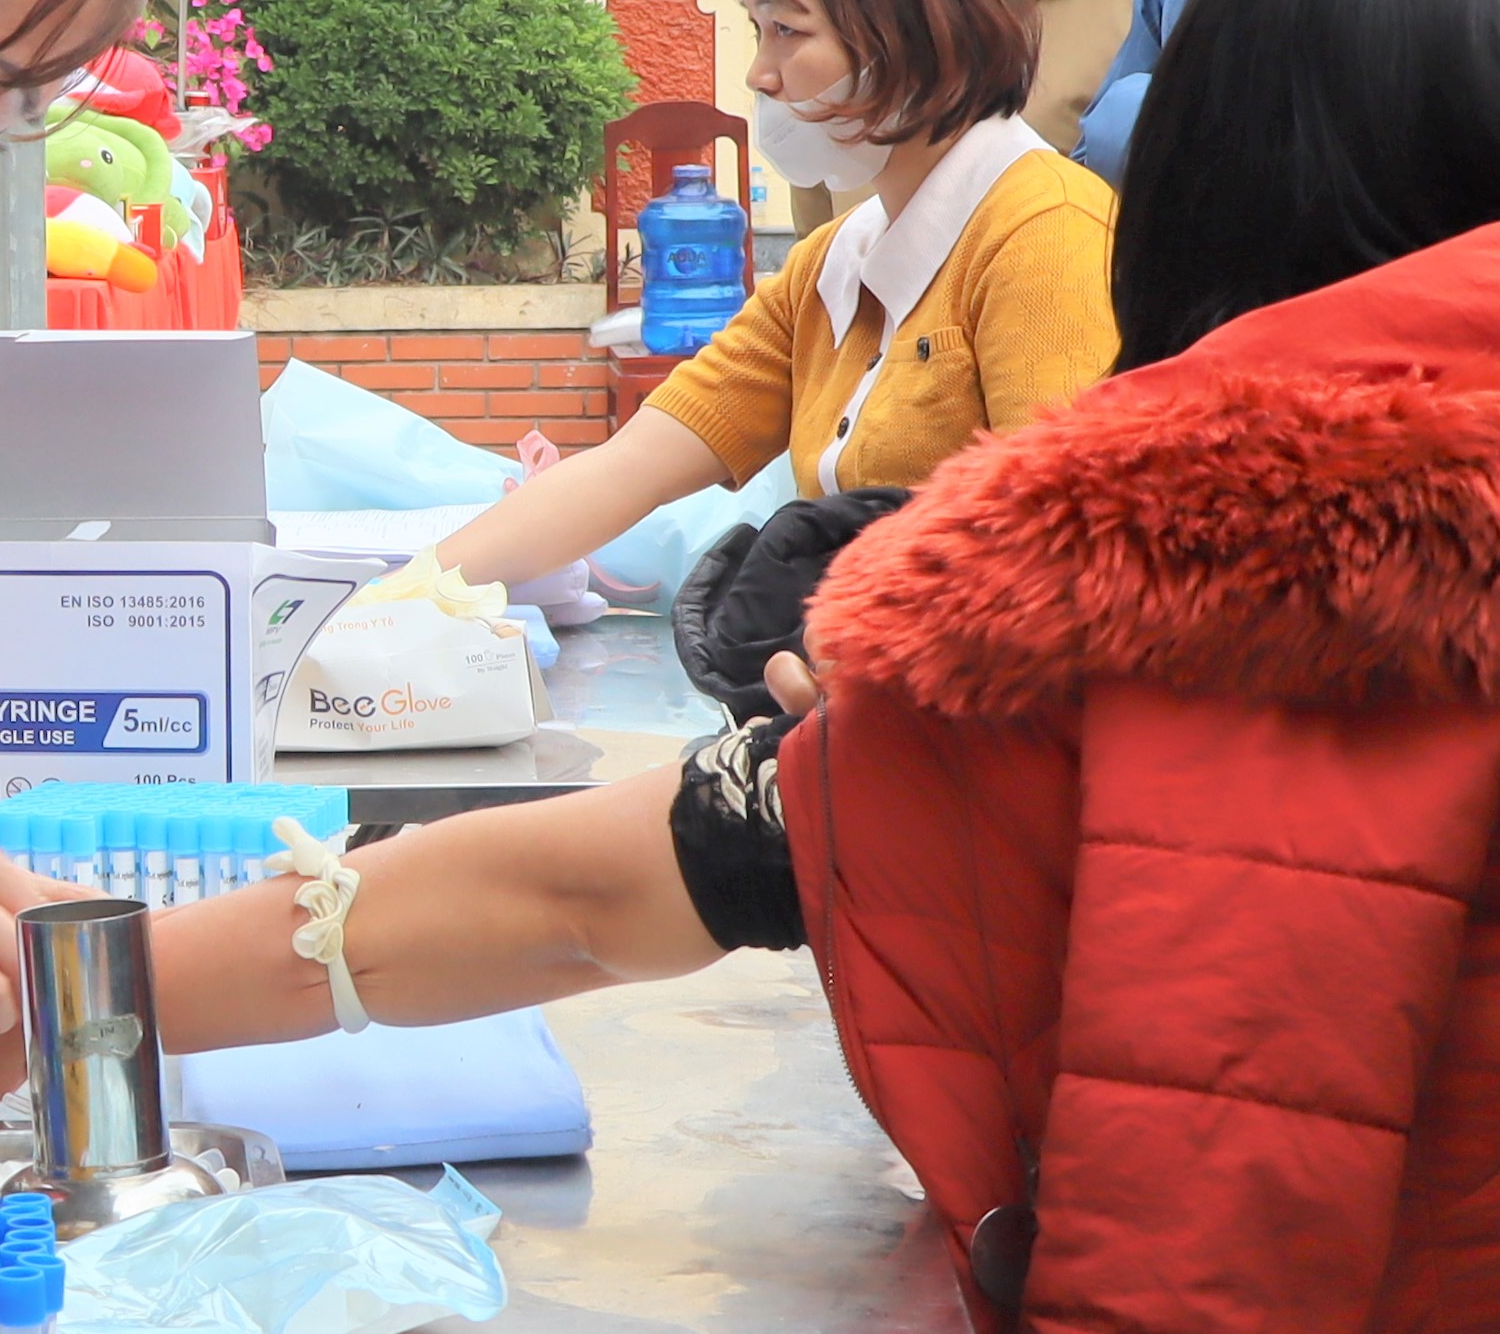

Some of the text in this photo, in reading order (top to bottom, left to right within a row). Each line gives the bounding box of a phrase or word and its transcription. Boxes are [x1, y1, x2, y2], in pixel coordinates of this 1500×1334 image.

[60, 596, 206, 609] EN ISO 13485:2016
[87, 615, 206, 628] ISO 9001:2015
[337, 619, 368, 633] Trong
[370, 620, 380, 628] Y
[465, 652, 484, 664] 100
[309, 682, 452, 717] Bee Glove
[123, 708, 193, 734] 5ml/cc
[309, 718, 415, 733] Protect Your Life
[39, 729, 75, 746] USE
